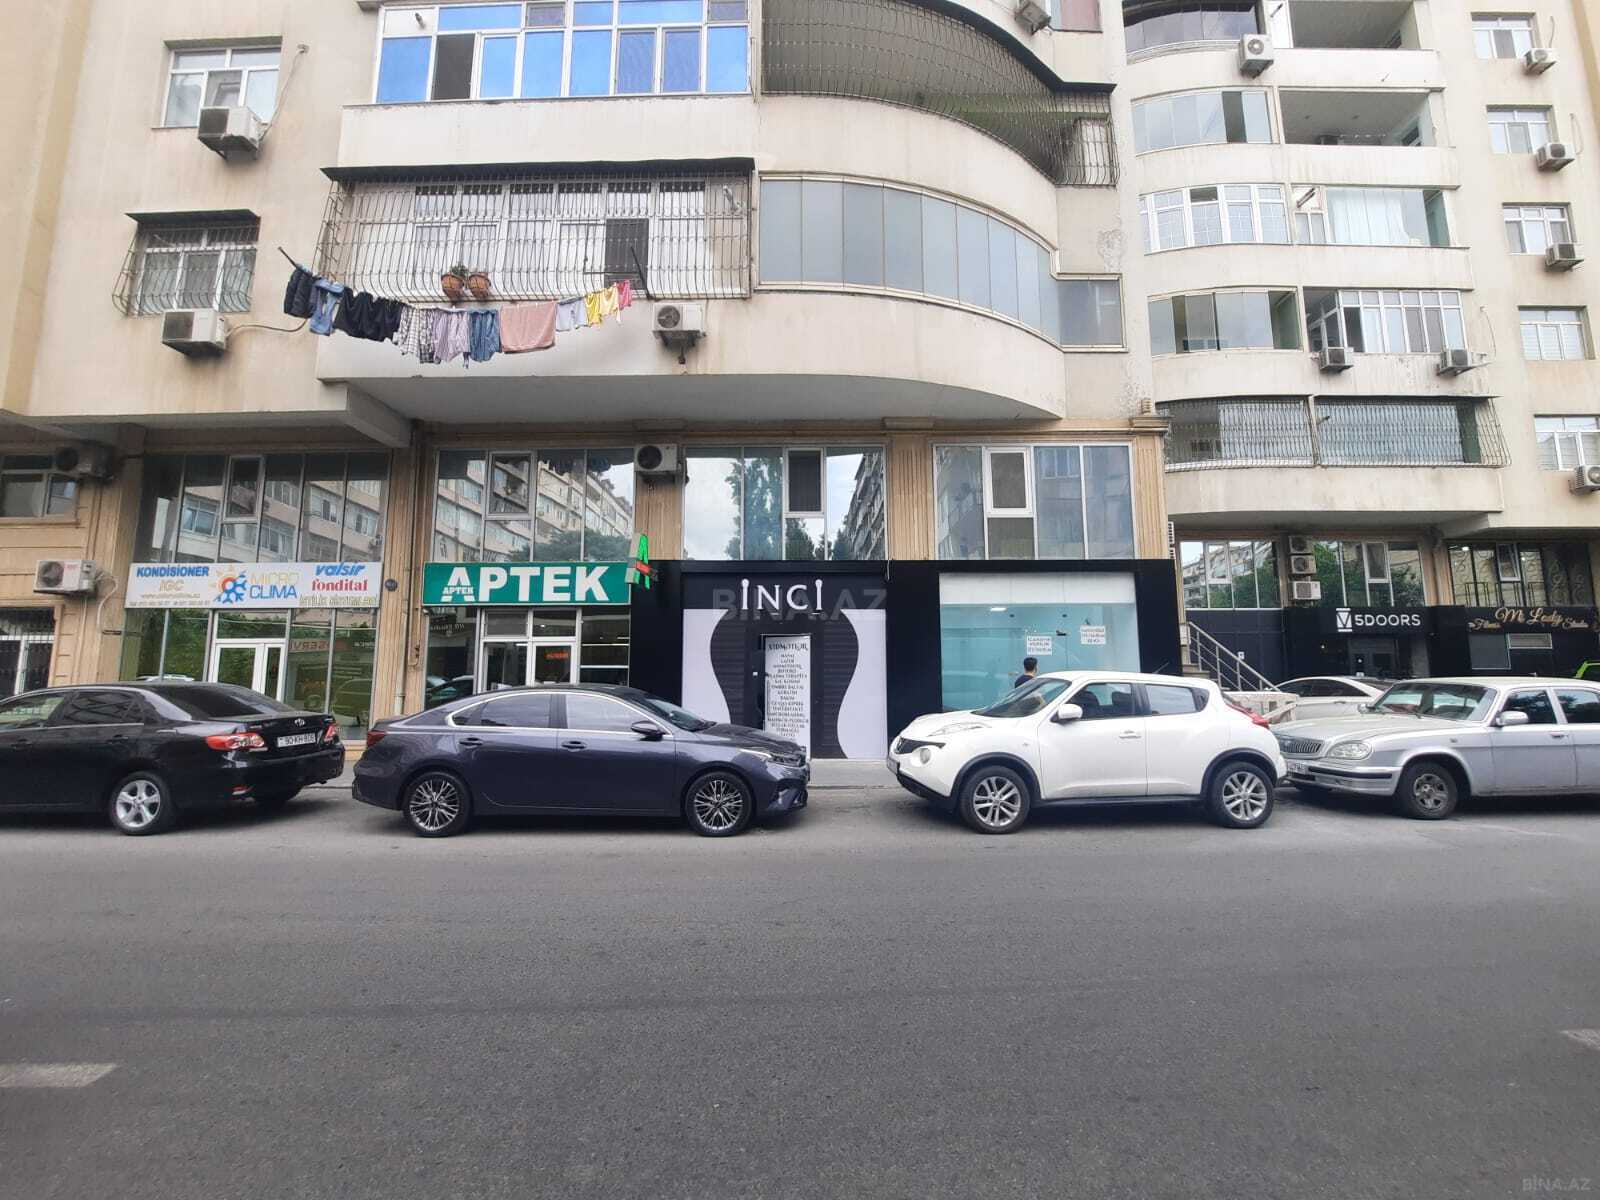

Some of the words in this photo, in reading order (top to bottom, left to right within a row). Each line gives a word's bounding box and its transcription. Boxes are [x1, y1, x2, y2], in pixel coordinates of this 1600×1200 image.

[315, 561, 365, 576] valsir
[249, 584, 297, 599] CLIMA
[312, 578, 367, 591] fondital
[441, 566, 609, 602] APTEK
[1354, 613, 1421, 626] 5DOORS
